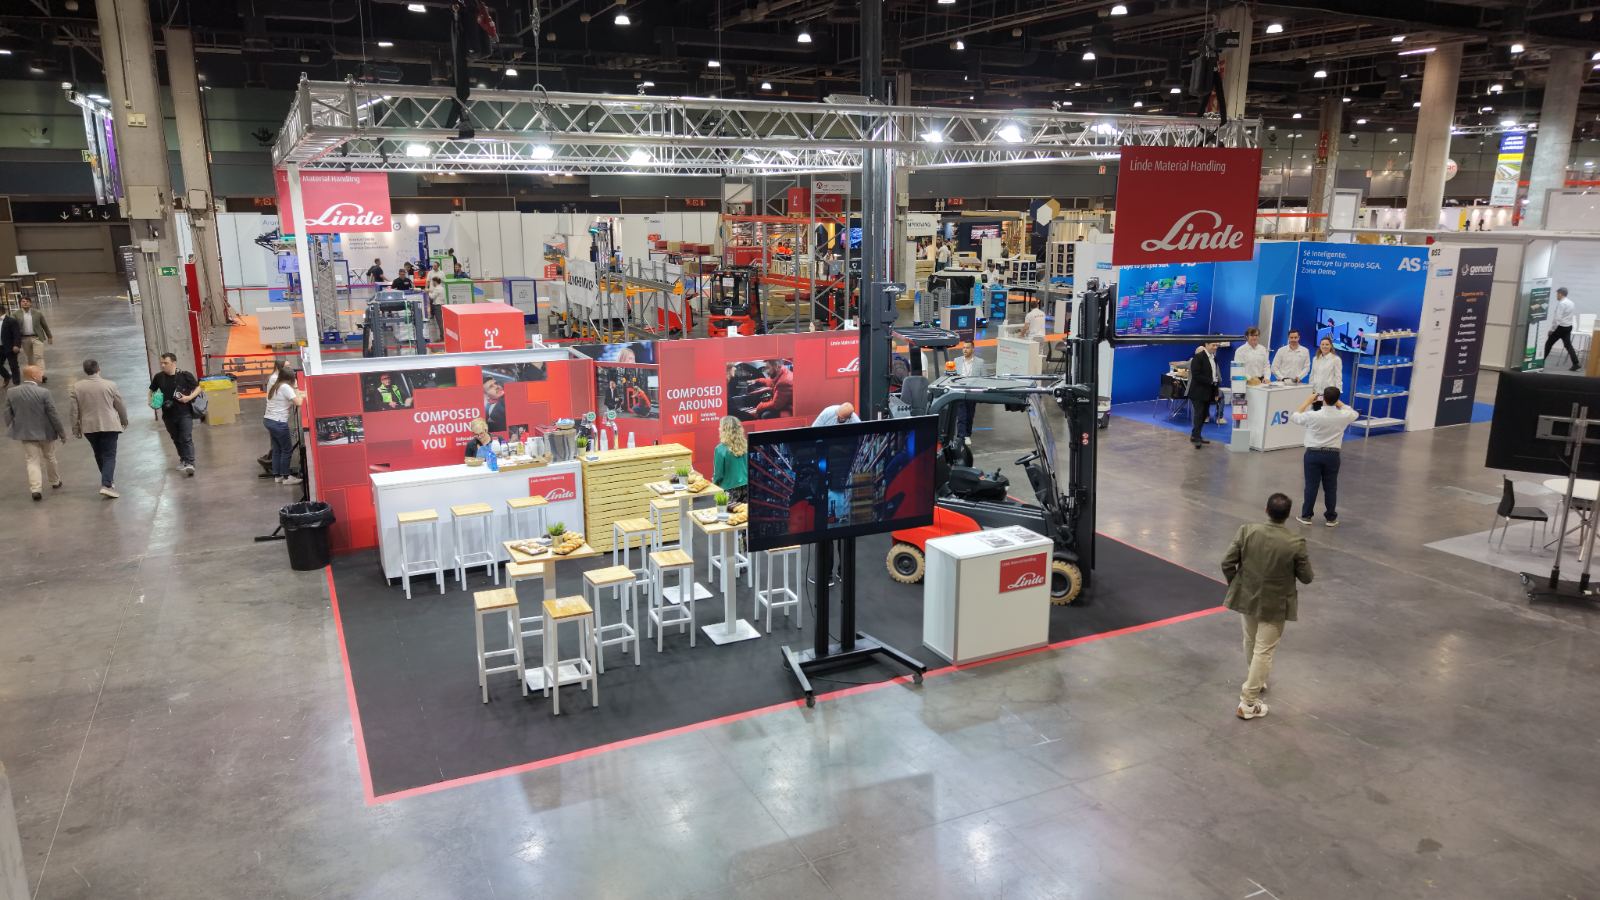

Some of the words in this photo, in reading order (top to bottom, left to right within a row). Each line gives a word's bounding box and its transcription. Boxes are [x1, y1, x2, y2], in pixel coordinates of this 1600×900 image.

[1130, 157, 1152, 171] Linde
[1154, 158, 1189, 172] Material
[1190, 160, 1226, 174] Handling
[304, 202, 385, 226] Linde
[1140, 209, 1244, 252] Linde
[1397, 257, 1421, 272] AS
[666, 386, 723, 400] COMPOSED
[678, 398, 723, 411] AROUND
[413, 408, 480, 423] COMPOSED
[672, 413, 693, 425] YOU
[1270, 410, 1289, 426] AS
[429, 423, 473, 435] AROUN
[421, 438, 447, 450] YOU
[544, 487, 574, 500] Linde
[1007, 572, 1044, 589] Linde
